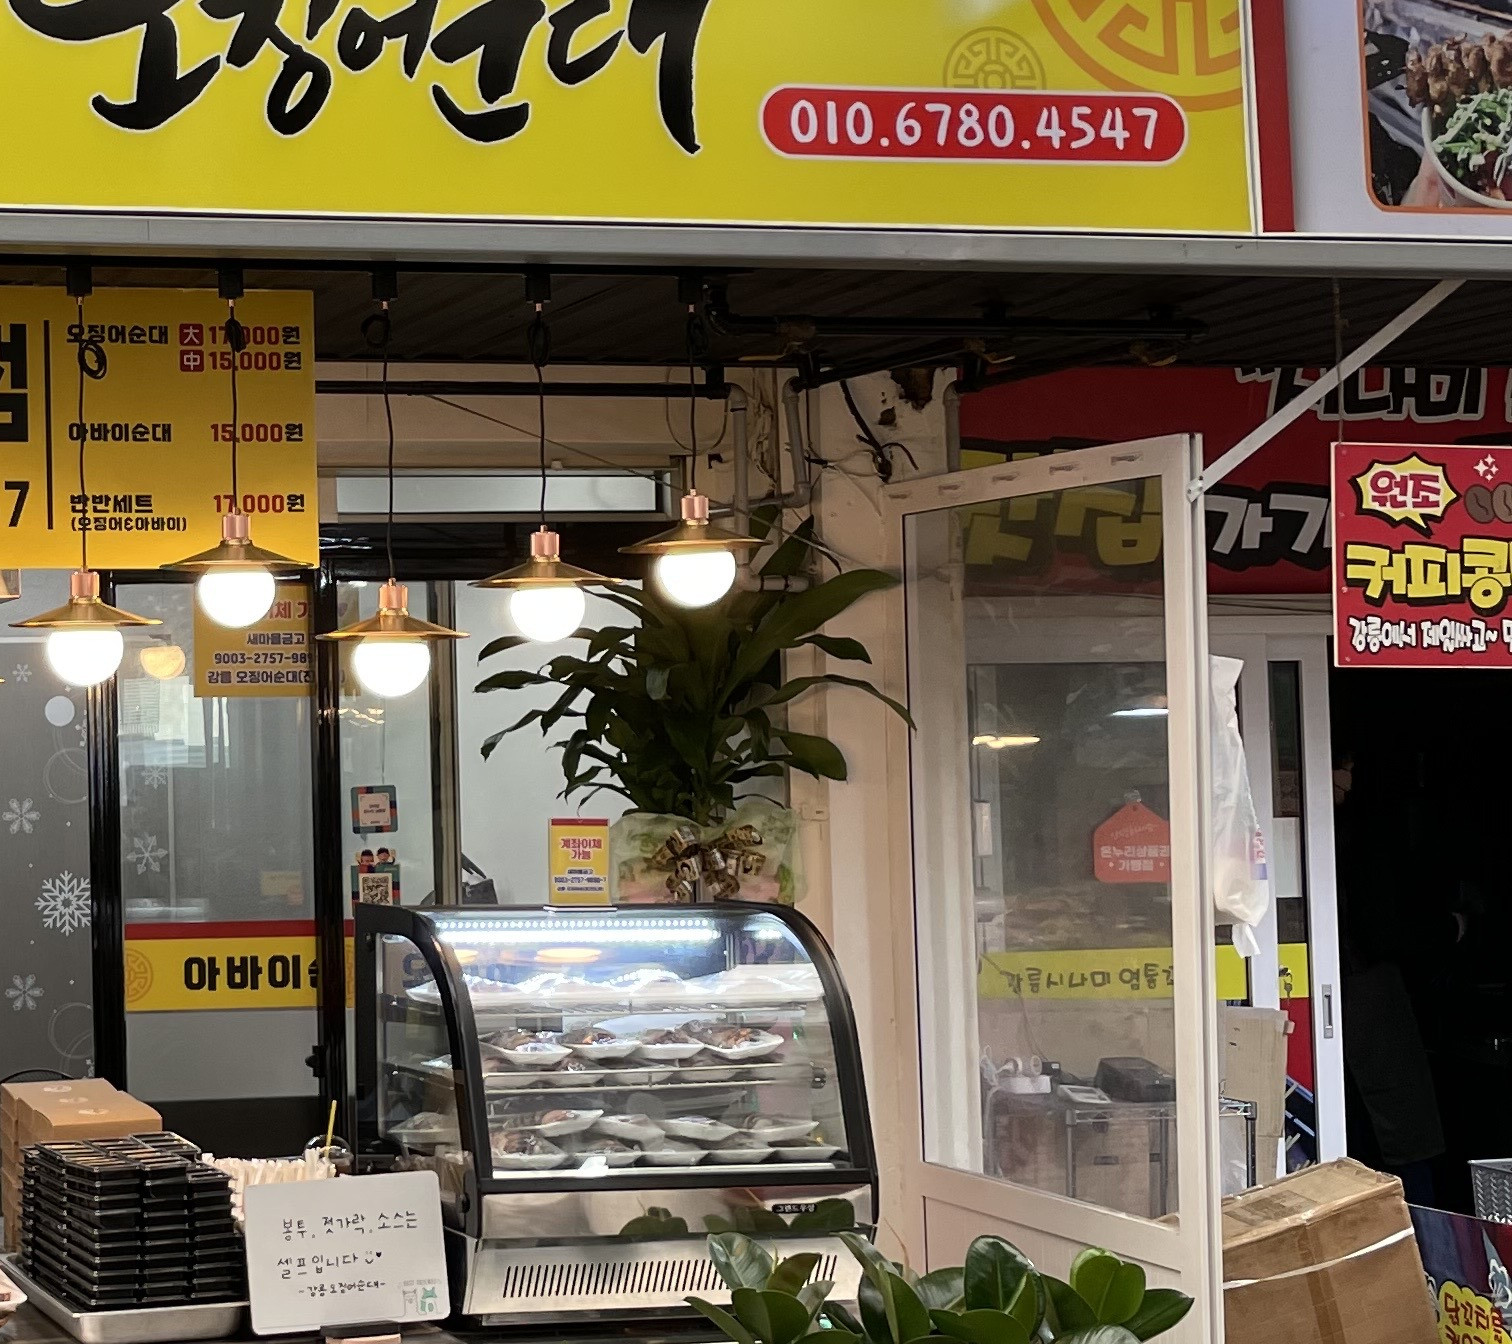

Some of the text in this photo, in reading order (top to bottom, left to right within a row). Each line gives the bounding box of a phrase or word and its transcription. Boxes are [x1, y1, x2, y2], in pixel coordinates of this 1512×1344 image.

[791, 99, 1159, 151] 010.6780.4547
[66, 324, 168, 345] 오징어순대
[182, 326, 200, 345] 大
[182, 352, 201, 371] 中
[68, 422, 172, 443] 아바이순대
[69, 494, 154, 514] 반반세트
[1346, 537, 1512, 609] 커피콩
[1348, 615, 1417, 653] 강릉에서
[561, 838, 603, 849] 계좌이체
[377, 1210, 418, 1230] 소스는
[277, 1253, 358, 1280] 셀프입니다
